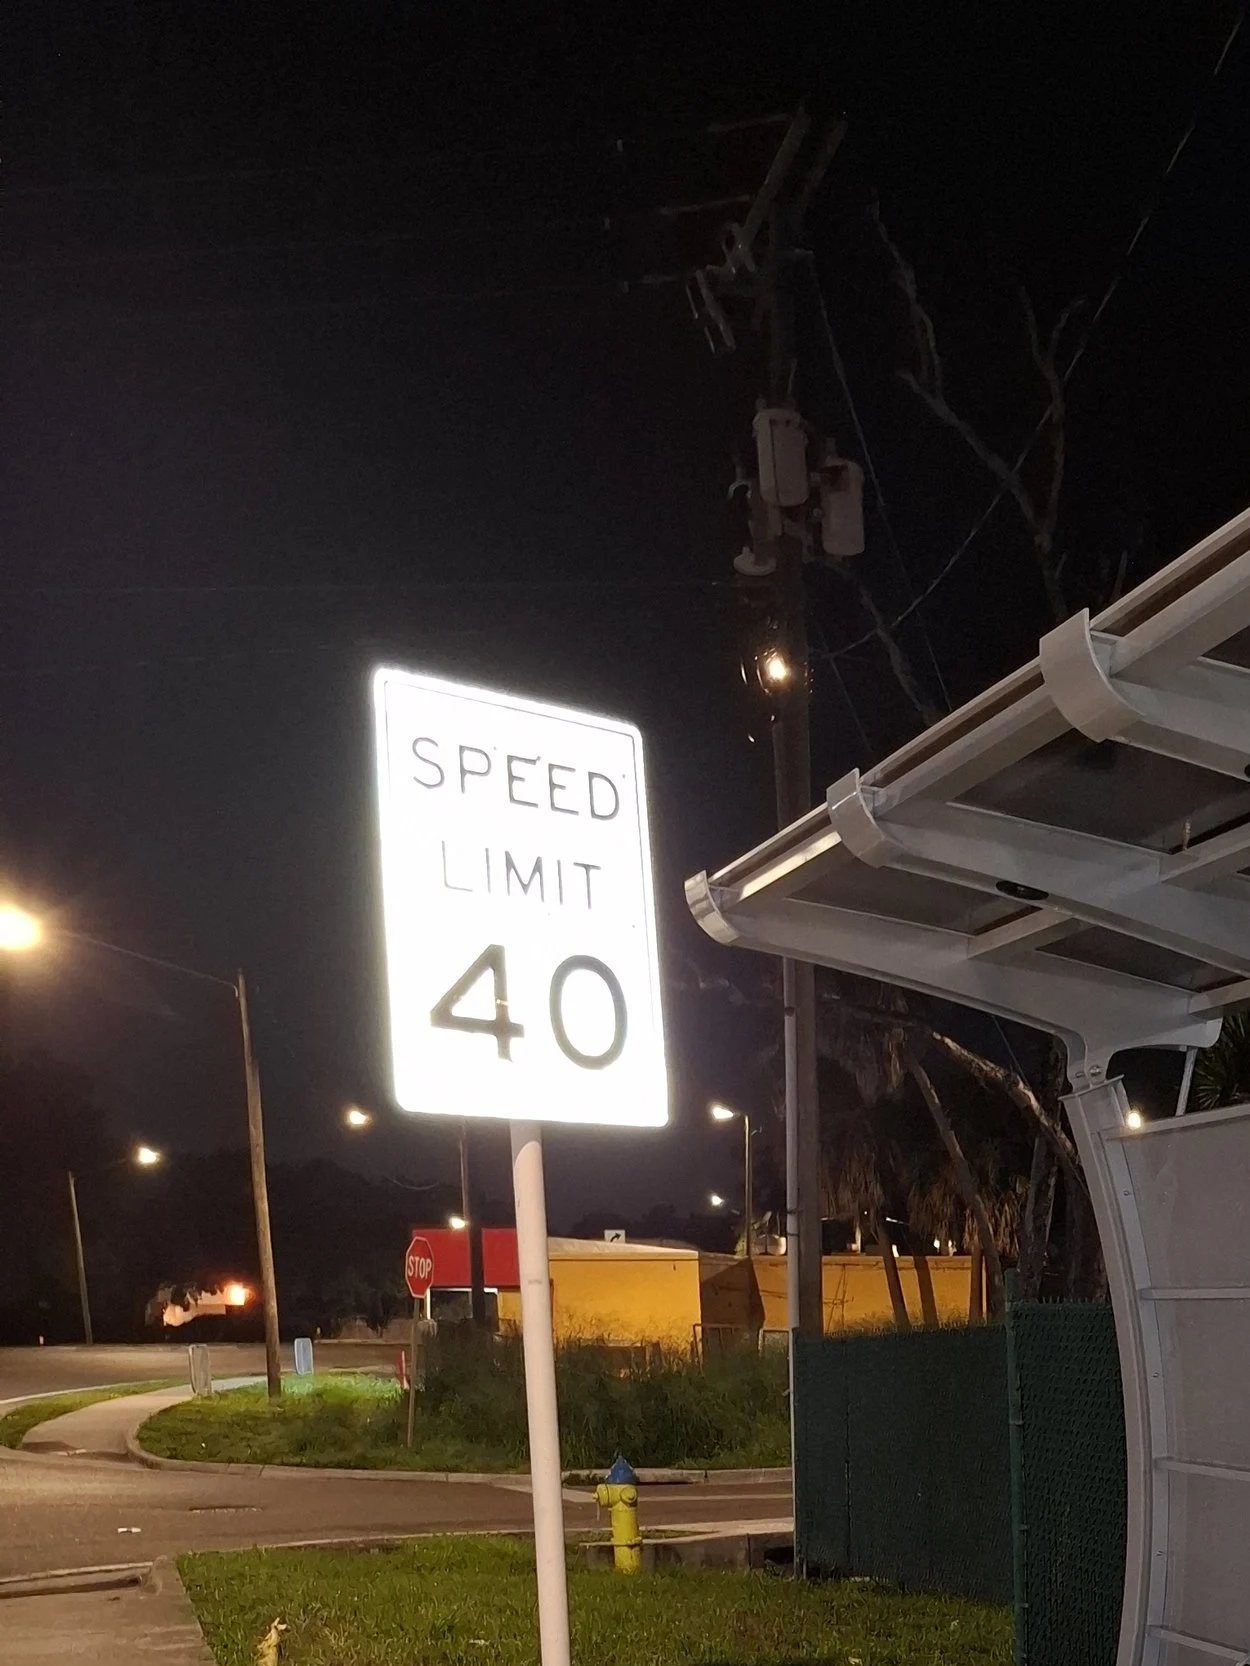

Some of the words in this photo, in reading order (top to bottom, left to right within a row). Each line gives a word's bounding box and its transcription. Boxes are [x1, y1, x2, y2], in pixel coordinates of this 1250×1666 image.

[411, 736, 620, 821] SPEED
[441, 840, 602, 910] LIMIT
[429, 943, 628, 1071] 40
[407, 1255, 432, 1279] STOP
